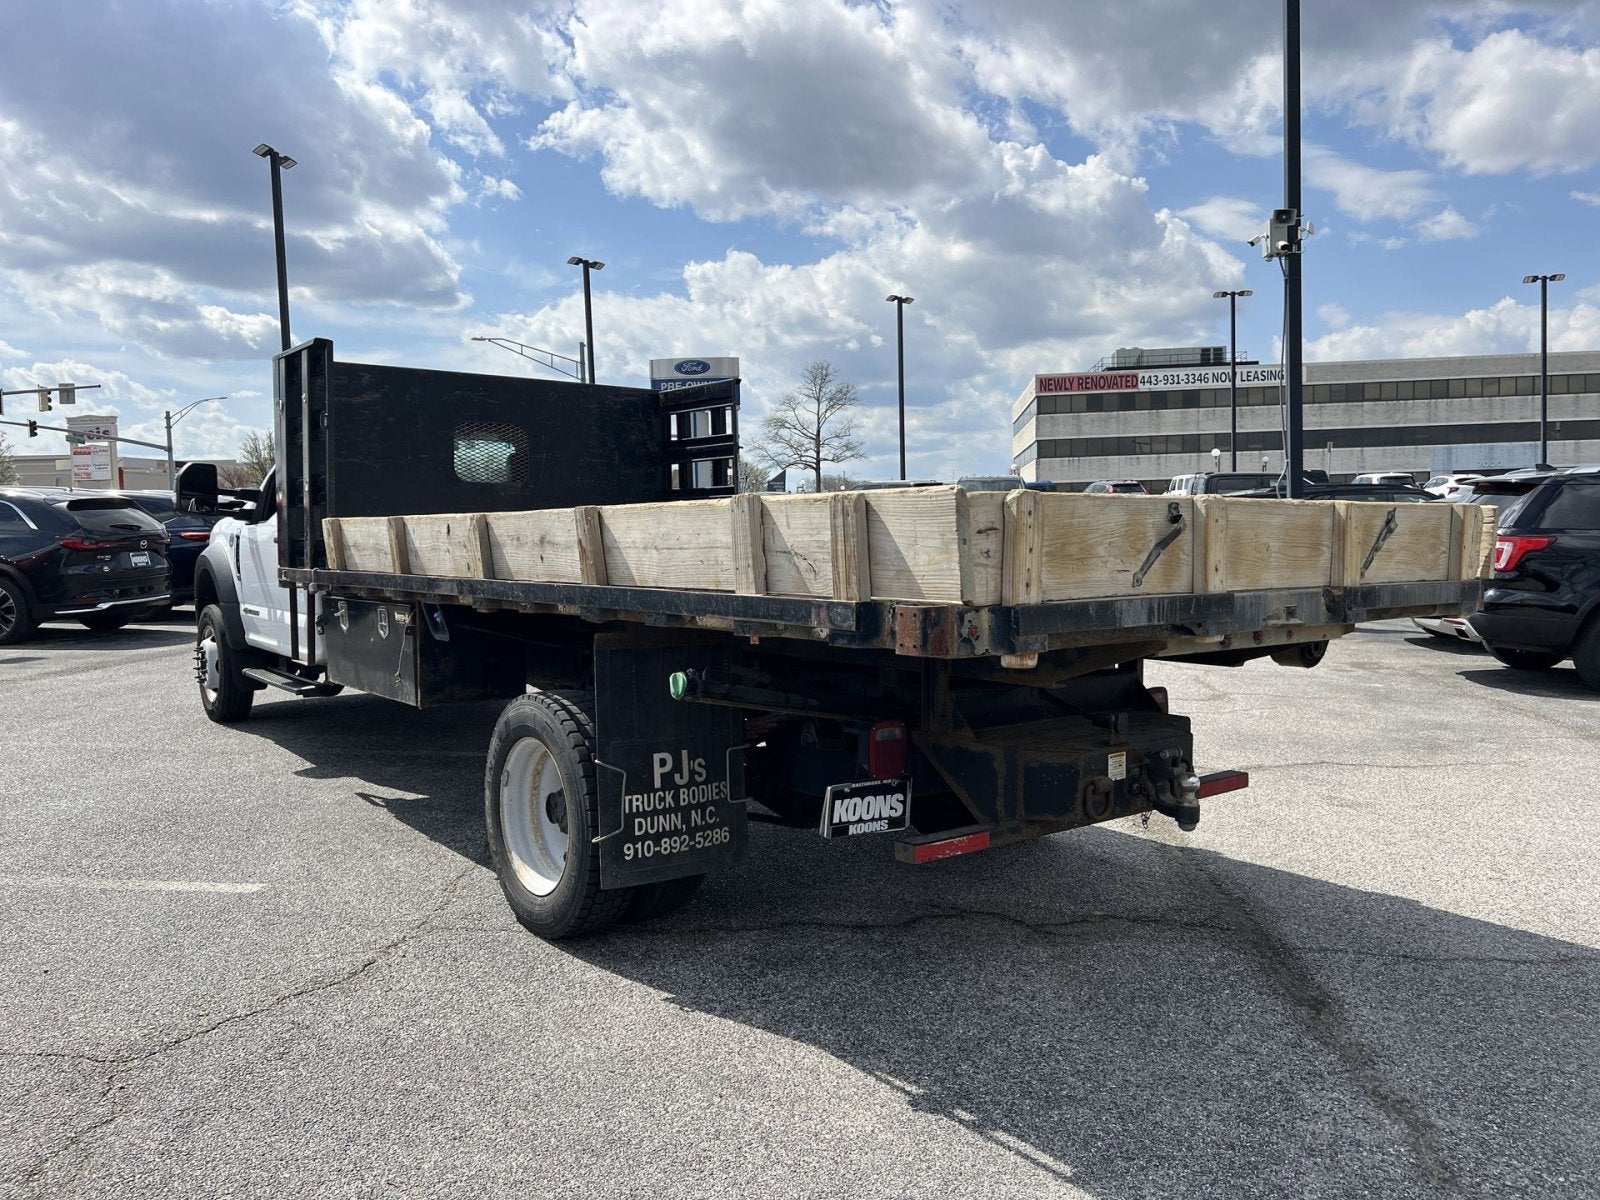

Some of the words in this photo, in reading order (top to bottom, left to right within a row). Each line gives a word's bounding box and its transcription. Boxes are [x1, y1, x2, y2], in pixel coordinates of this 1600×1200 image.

[681, 362, 703, 372] Ford
[1039, 376, 1075, 392] NEWLY
[1077, 374, 1138, 390] RENOVATED
[1139, 372, 1209, 386] 443-931-3346
[1240, 369, 1285, 383] LEASING
[624, 789, 675, 814] TRUCK
[680, 781, 727, 807] BODIES
[832, 793, 904, 824] KOONS
[634, 812, 686, 836] DUNN,
[691, 806, 720, 828] N.C.
[848, 819, 889, 836] KOONS
[623, 826, 730, 861] 910-892-5286
